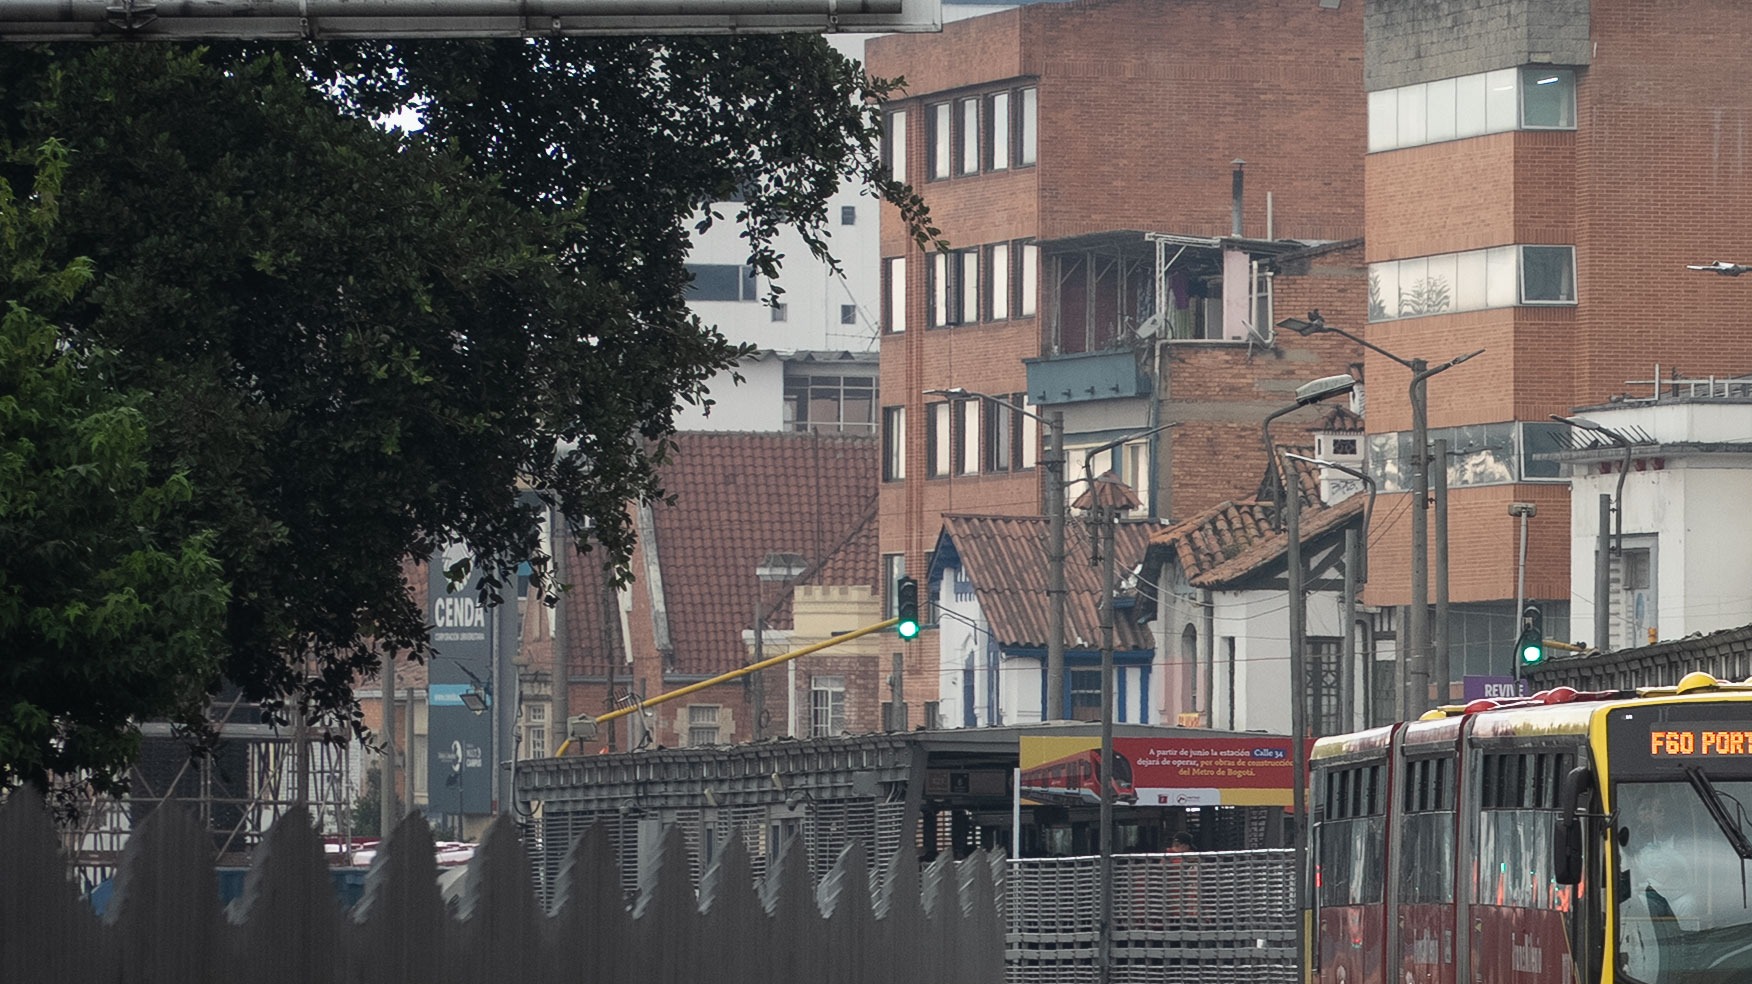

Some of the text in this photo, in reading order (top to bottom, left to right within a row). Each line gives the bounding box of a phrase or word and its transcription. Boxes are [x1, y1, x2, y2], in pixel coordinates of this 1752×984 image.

[434, 597, 485, 628] CENDA
[1651, 731, 1695, 755] F60
[1149, 748, 1284, 759] A partir de junio la estación Calle 34
[1136, 757, 1160, 768] dejará
[1161, 757, 1170, 766] de
[1171, 759, 1199, 768] operar,
[1200, 759, 1213, 768] por
[1214, 758, 1235, 767] obras
[1236, 758, 1246, 767] de
[1178, 767, 1256, 779] del Metro de Bogotá.
